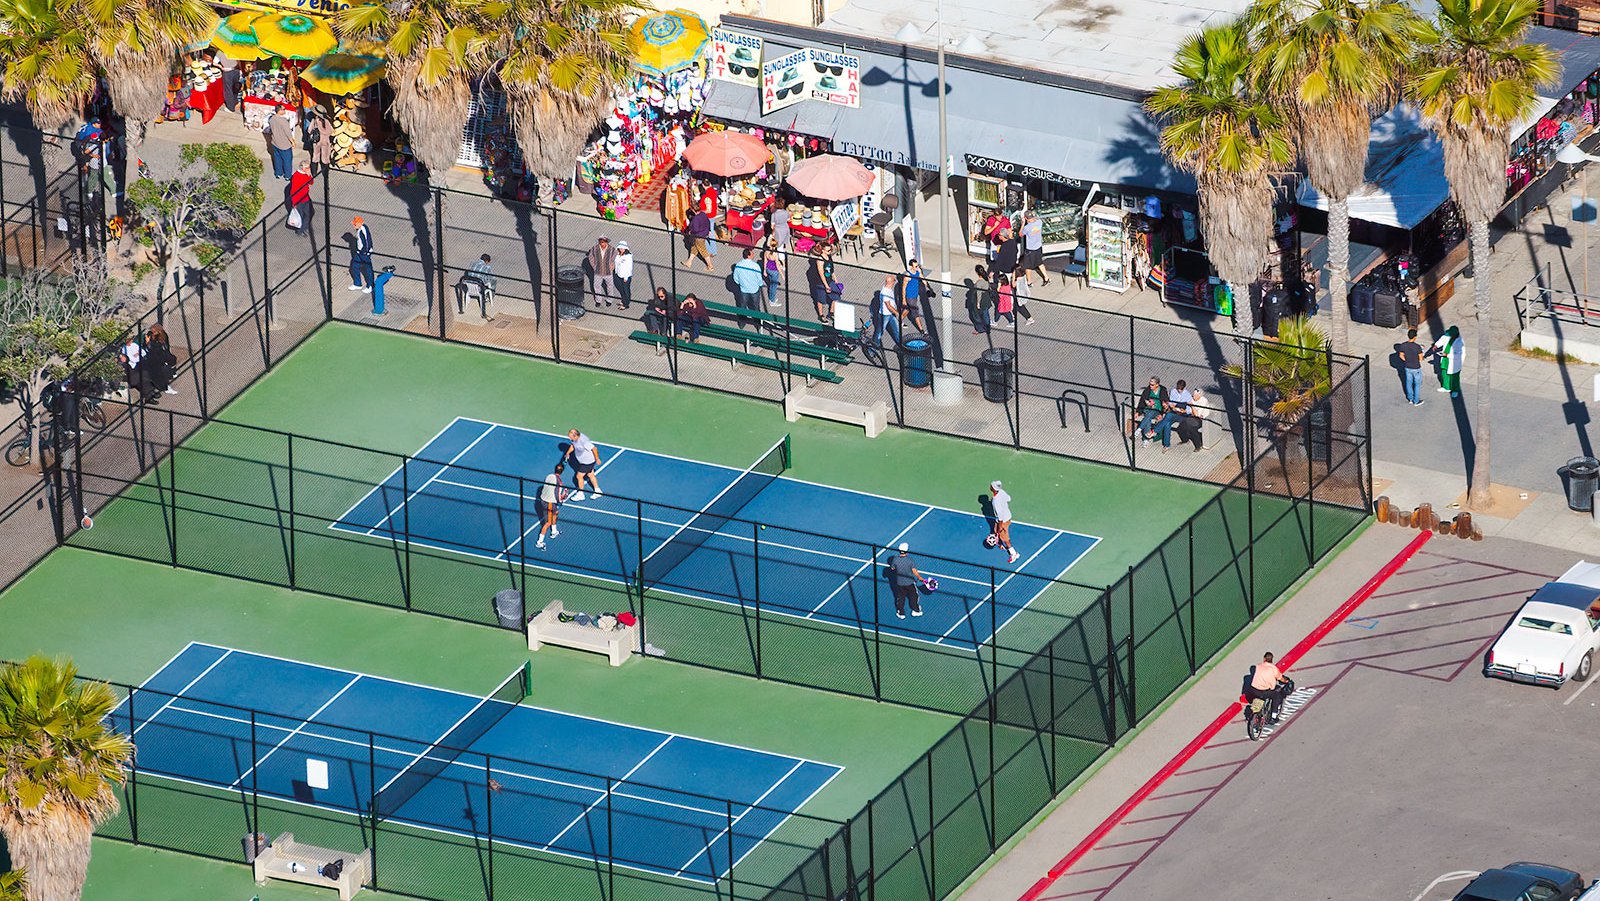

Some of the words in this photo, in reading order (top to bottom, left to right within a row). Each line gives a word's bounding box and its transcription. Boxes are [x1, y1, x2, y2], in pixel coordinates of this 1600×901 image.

[714, 30, 760, 50] SUNGLASSES
[715, 42, 726, 76] HAT
[764, 51, 806, 75] SUNGLASSES
[809, 49, 858, 68] SUNGLASSES
[765, 75, 774, 110] HAT
[848, 69, 858, 104] HAT
[841, 141, 892, 161] TATTOO
[968, 155, 1014, 173] ZORRO
[1274, 686, 1317, 726] ARKING
